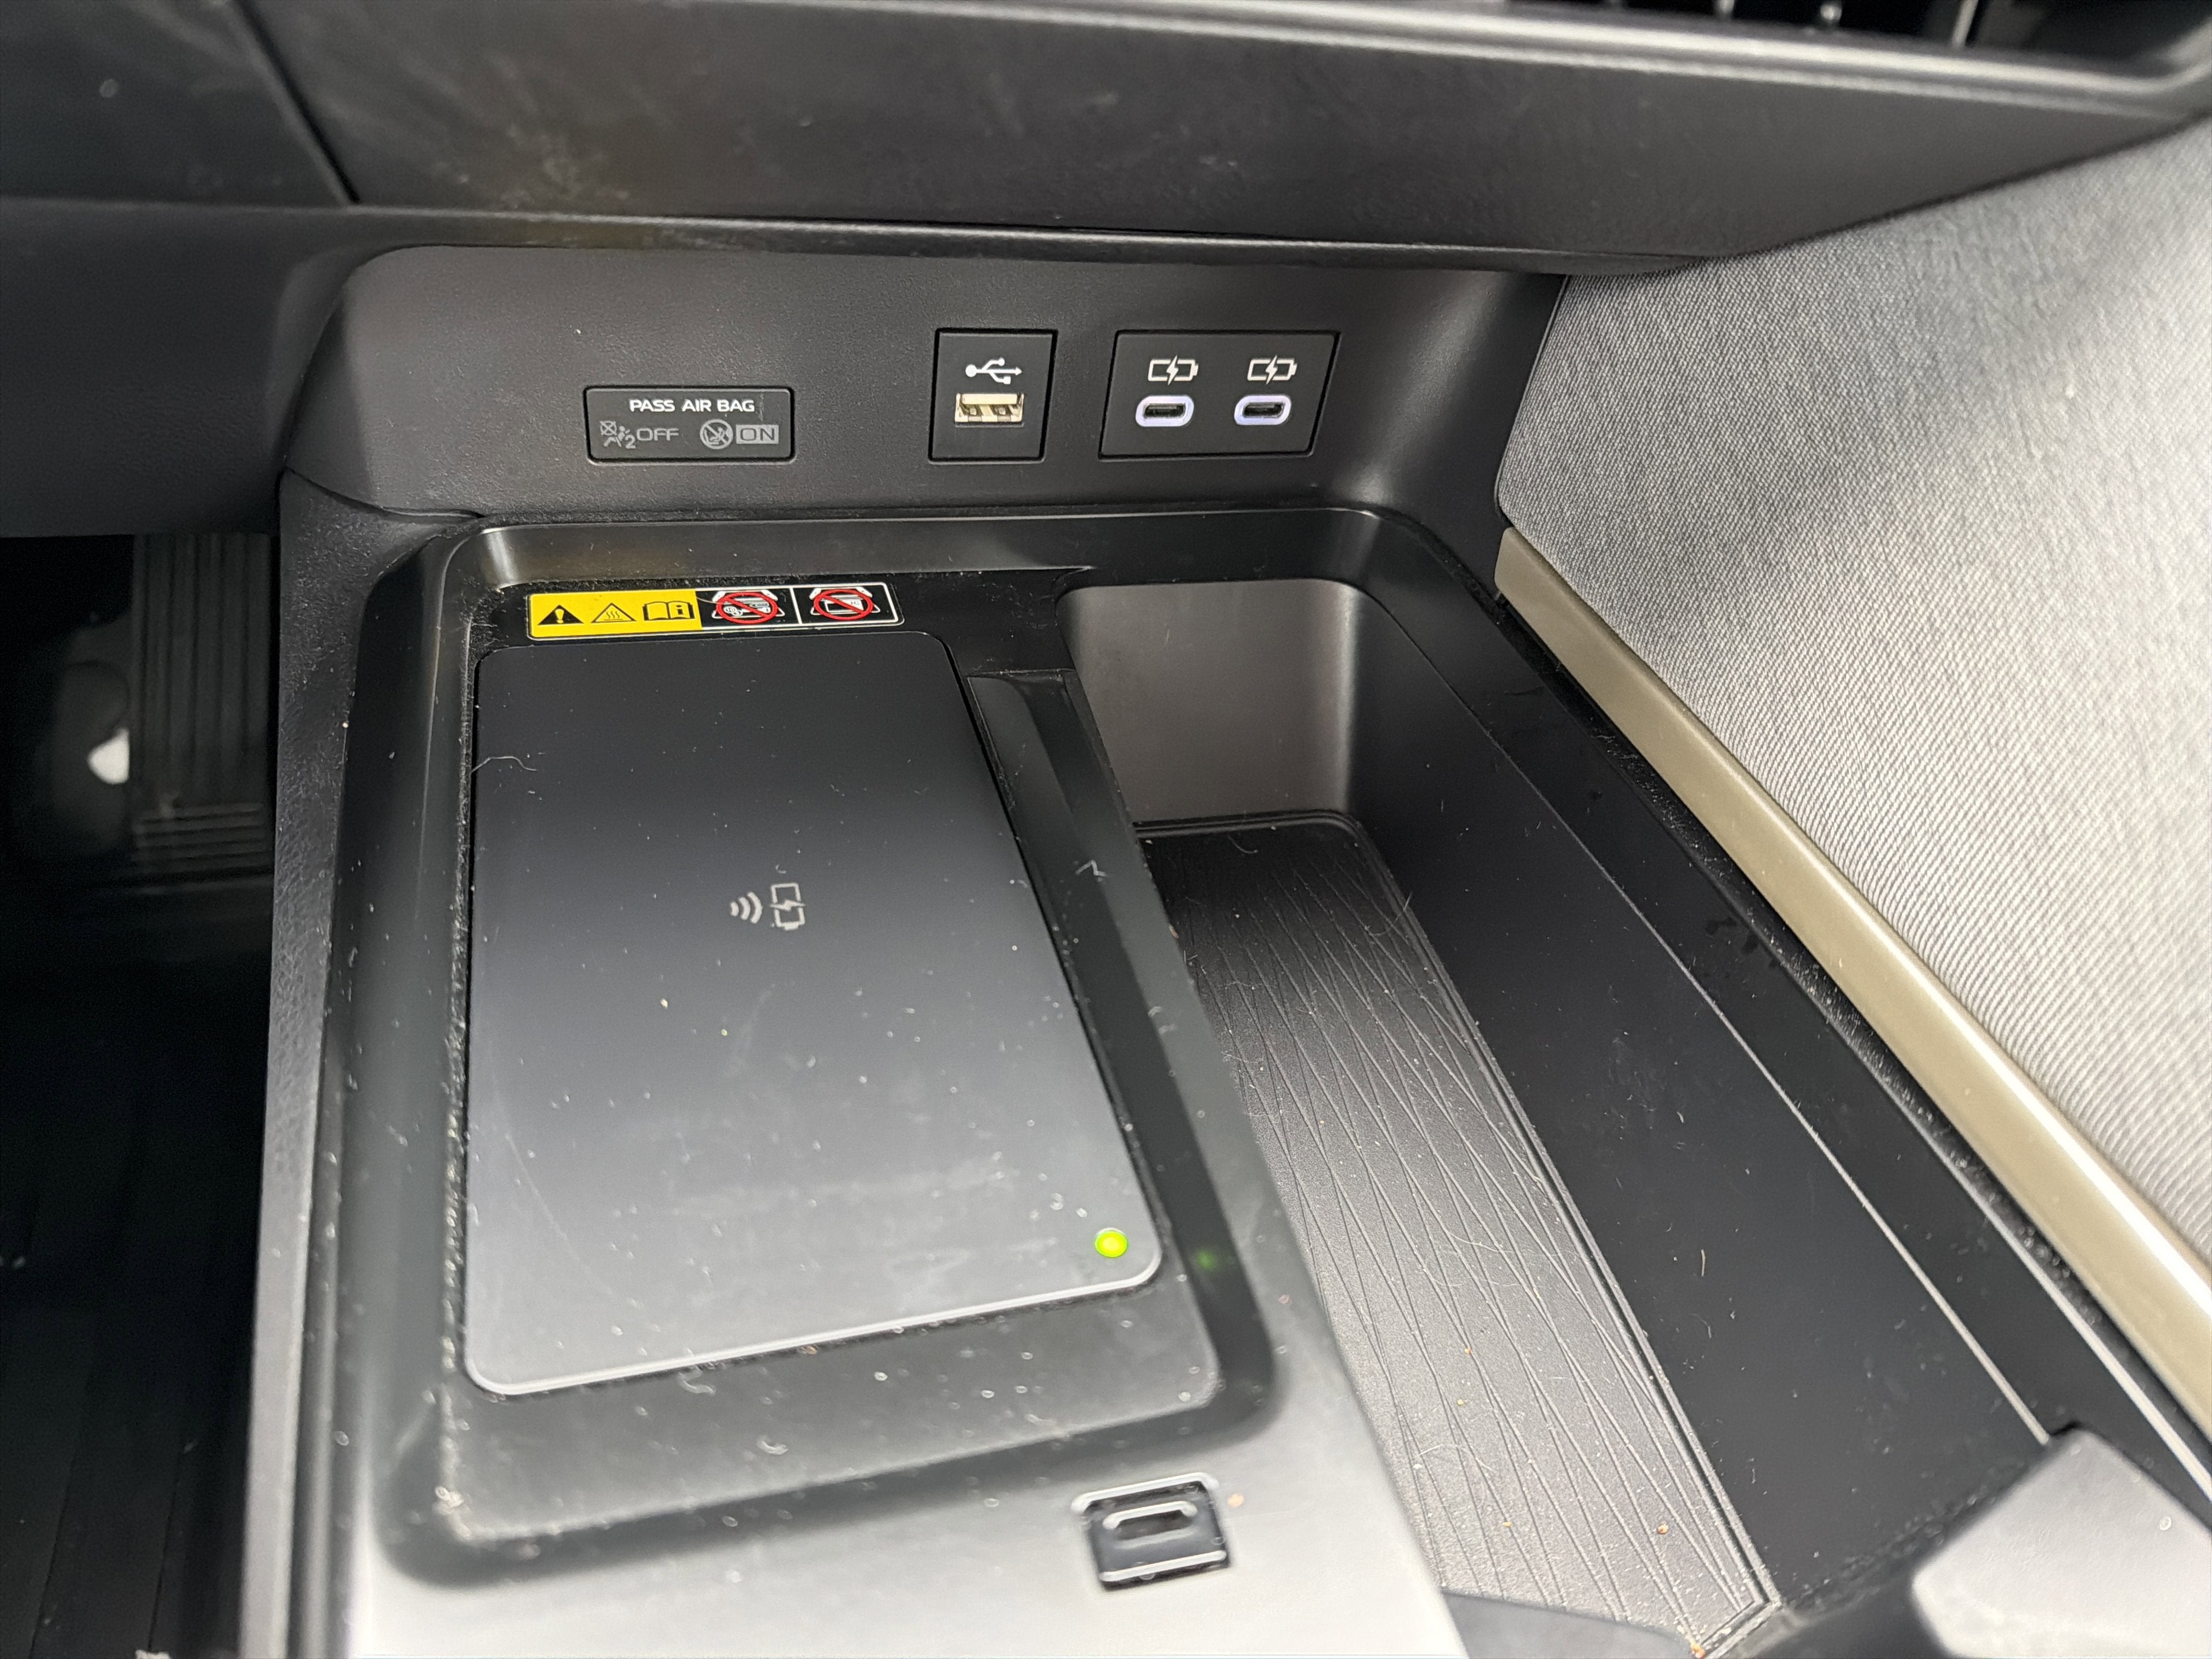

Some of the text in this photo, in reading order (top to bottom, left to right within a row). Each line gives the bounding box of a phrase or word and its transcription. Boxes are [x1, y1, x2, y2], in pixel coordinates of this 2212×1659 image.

[629, 399, 755, 412] PASS AIR BAG
[636, 428, 680, 441] OFF
[740, 427, 776, 441] ON
